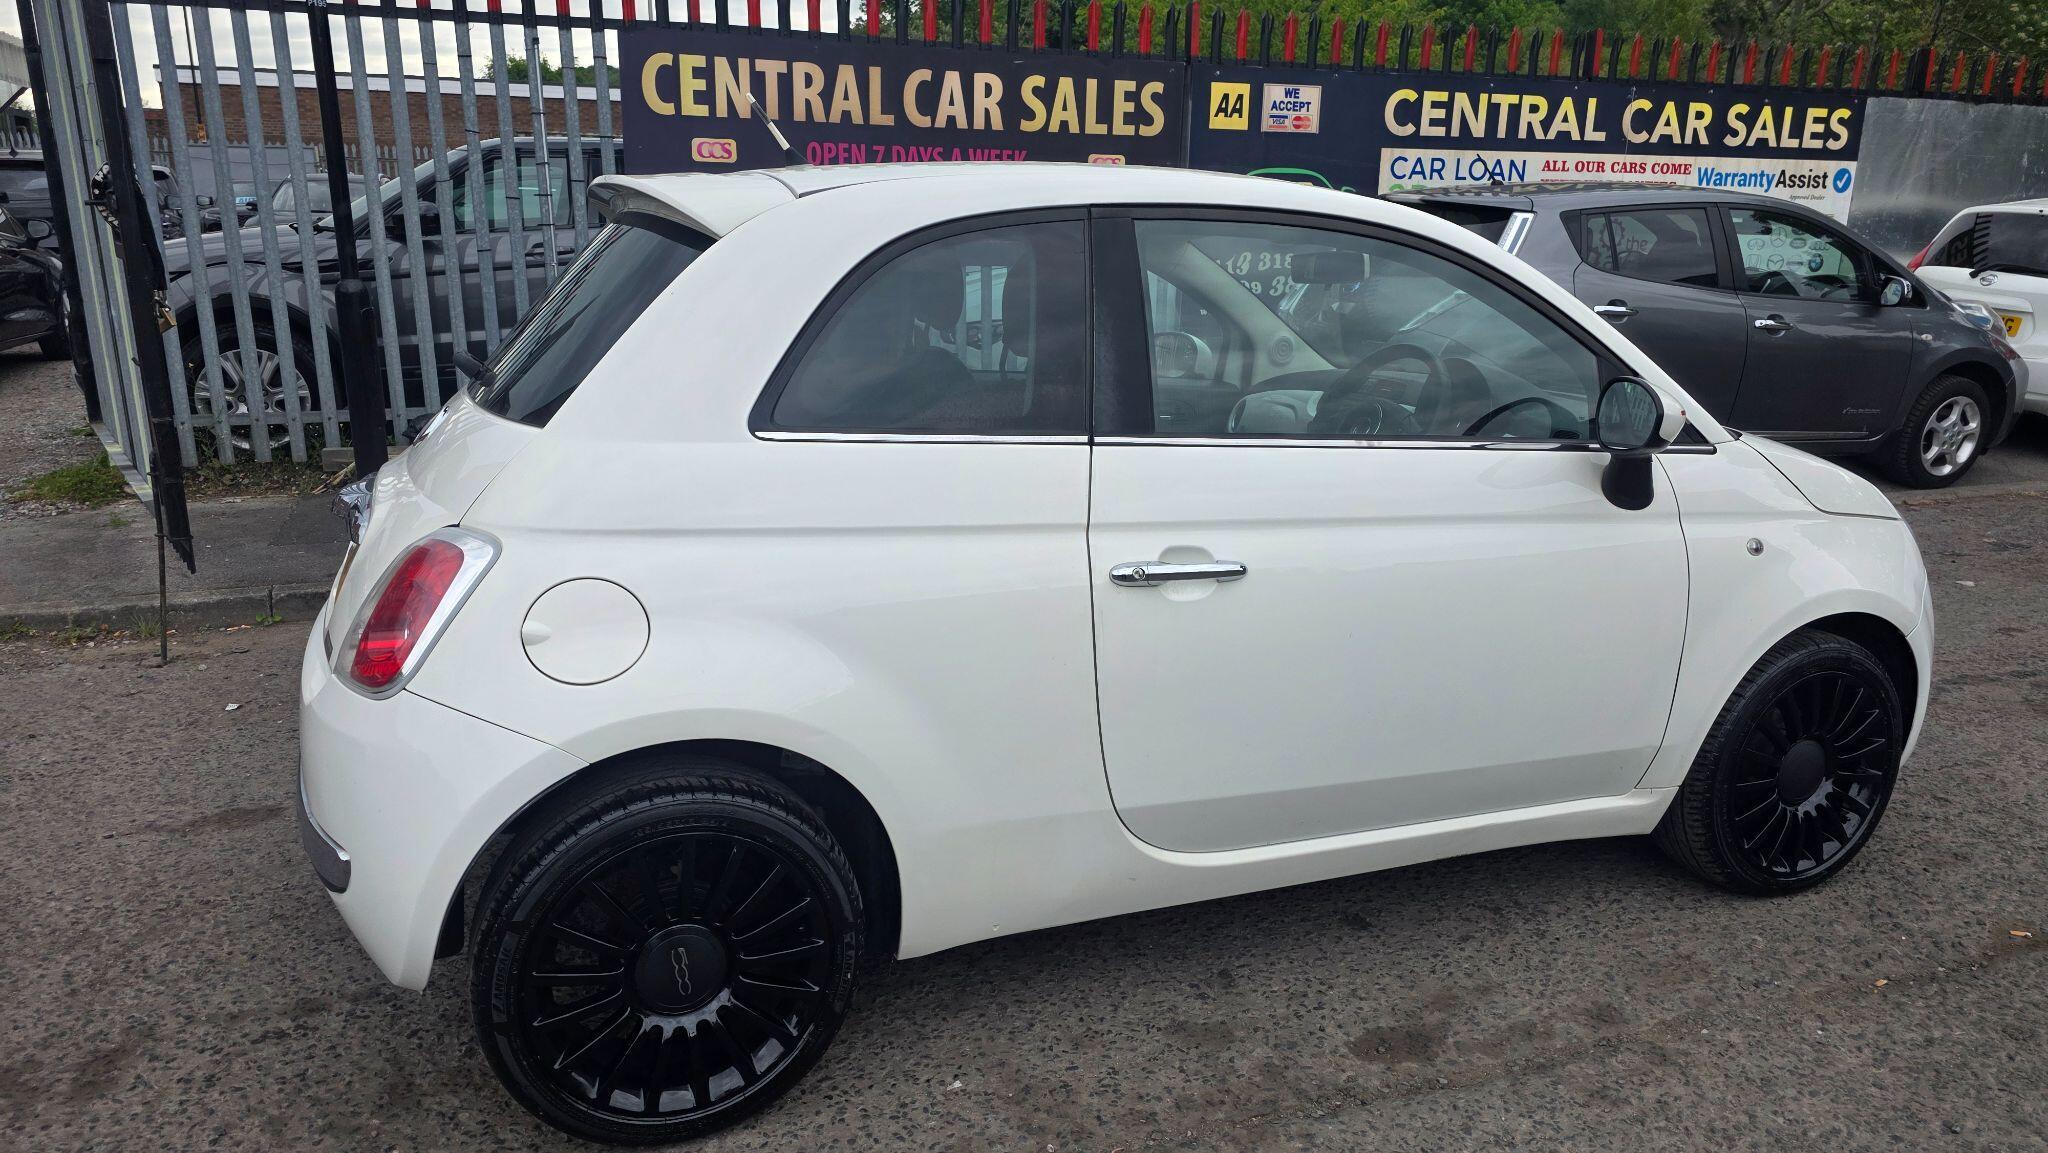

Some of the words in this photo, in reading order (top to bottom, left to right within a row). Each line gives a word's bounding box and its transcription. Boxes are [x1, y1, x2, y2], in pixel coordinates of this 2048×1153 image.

[642, 52, 895, 126] CENTRAL
[903, 68, 1004, 131] CAR
[1020, 74, 1165, 137] SALES
[1213, 92, 1244, 118] AA
[1284, 87, 1300, 99] WE
[1270, 100, 1312, 113] ACCEPT
[1384, 88, 1607, 141] CENTRAL
[1621, 98, 1713, 145] CAR
[1722, 103, 1852, 150] SALES
[806, 141, 866, 165] OPEN
[872, 145, 885, 163] 7
[892, 145, 944, 162] DAYS
[1390, 155, 1446, 180] CAR
[1454, 157, 1527, 182] LOAN
[1541, 159, 1570, 172] ALL
[1574, 160, 1606, 173] OUR
[1610, 161, 1647, 174] CARS
[1651, 162, 1693, 175] COME
